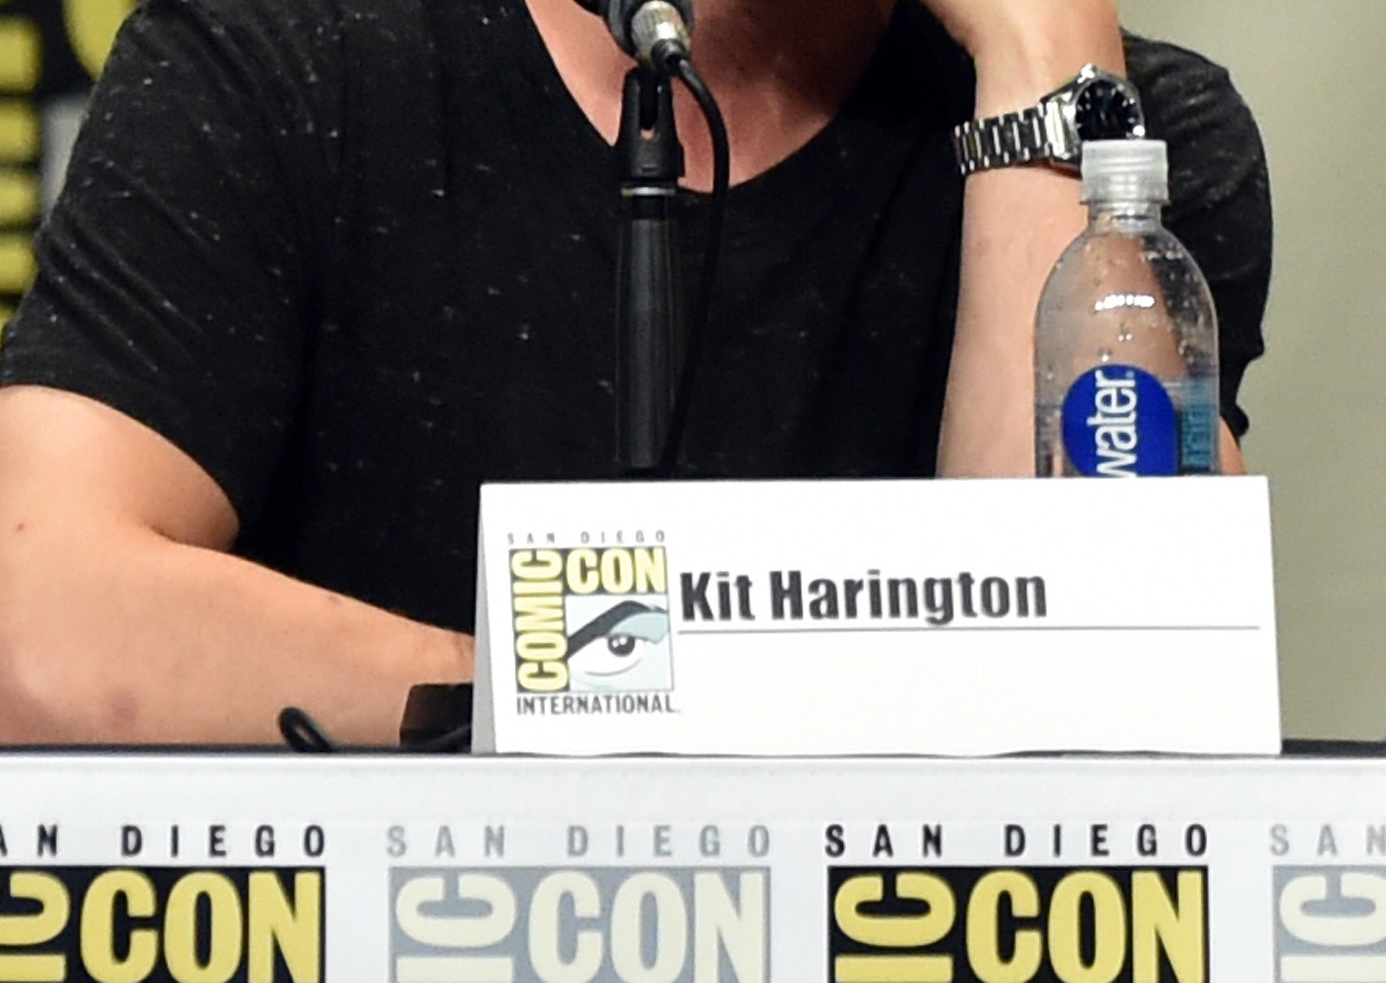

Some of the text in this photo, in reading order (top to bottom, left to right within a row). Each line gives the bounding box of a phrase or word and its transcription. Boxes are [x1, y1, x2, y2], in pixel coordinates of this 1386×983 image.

[507, 529, 665, 545] SAN DIEGO
[565, 547, 666, 595] CON
[511, 548, 569, 692] COMIC
[680, 568, 1048, 626] Kit Harington
[516, 693, 676, 716] INTERNATIONAL
[121, 824, 326, 858] DIEGO
[387, 824, 771, 858] SAN DIEGO
[825, 823, 1208, 858] SAN DIEGO
[80, 870, 321, 983] CON
[527, 871, 765, 983] CON
[966, 870, 1204, 983] CON
